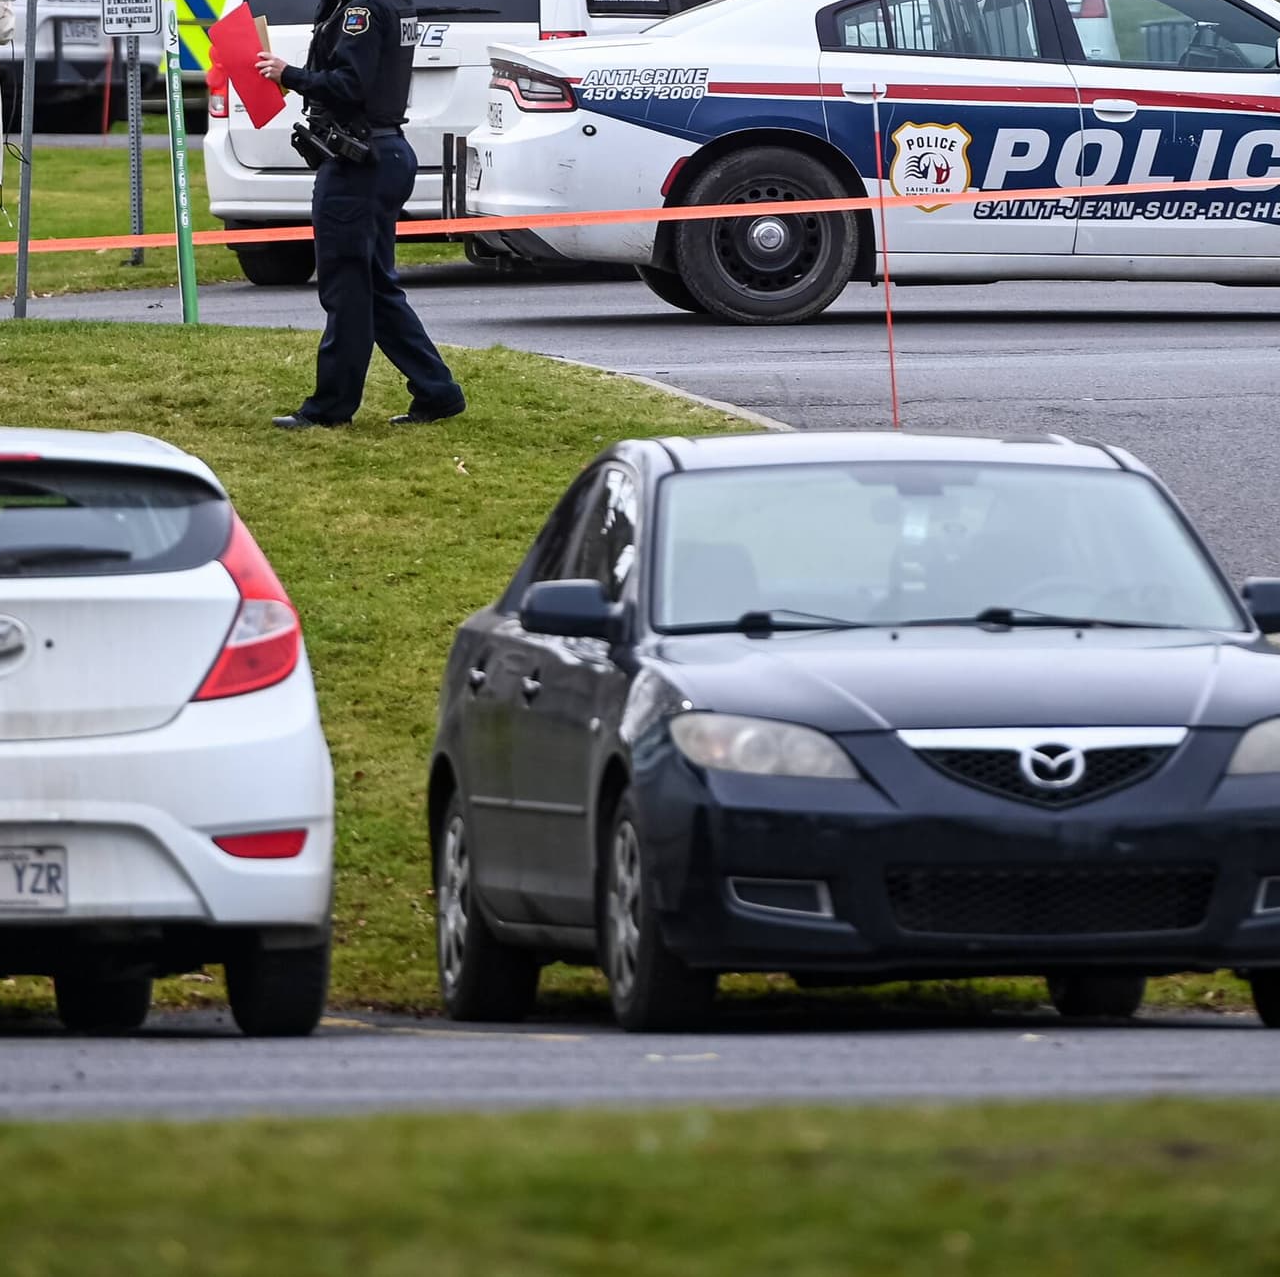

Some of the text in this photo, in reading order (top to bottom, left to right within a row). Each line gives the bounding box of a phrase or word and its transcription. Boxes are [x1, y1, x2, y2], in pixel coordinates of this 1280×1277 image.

[116, 16, 150, 24] INFRACTION
[583, 68, 708, 86] ANTI-CRIME
[582, 86, 705, 101] 450 357-2000
[905, 135, 958, 152] POLICE
[485, 150, 493, 168] 11
[14, 862, 62, 894] YZR
